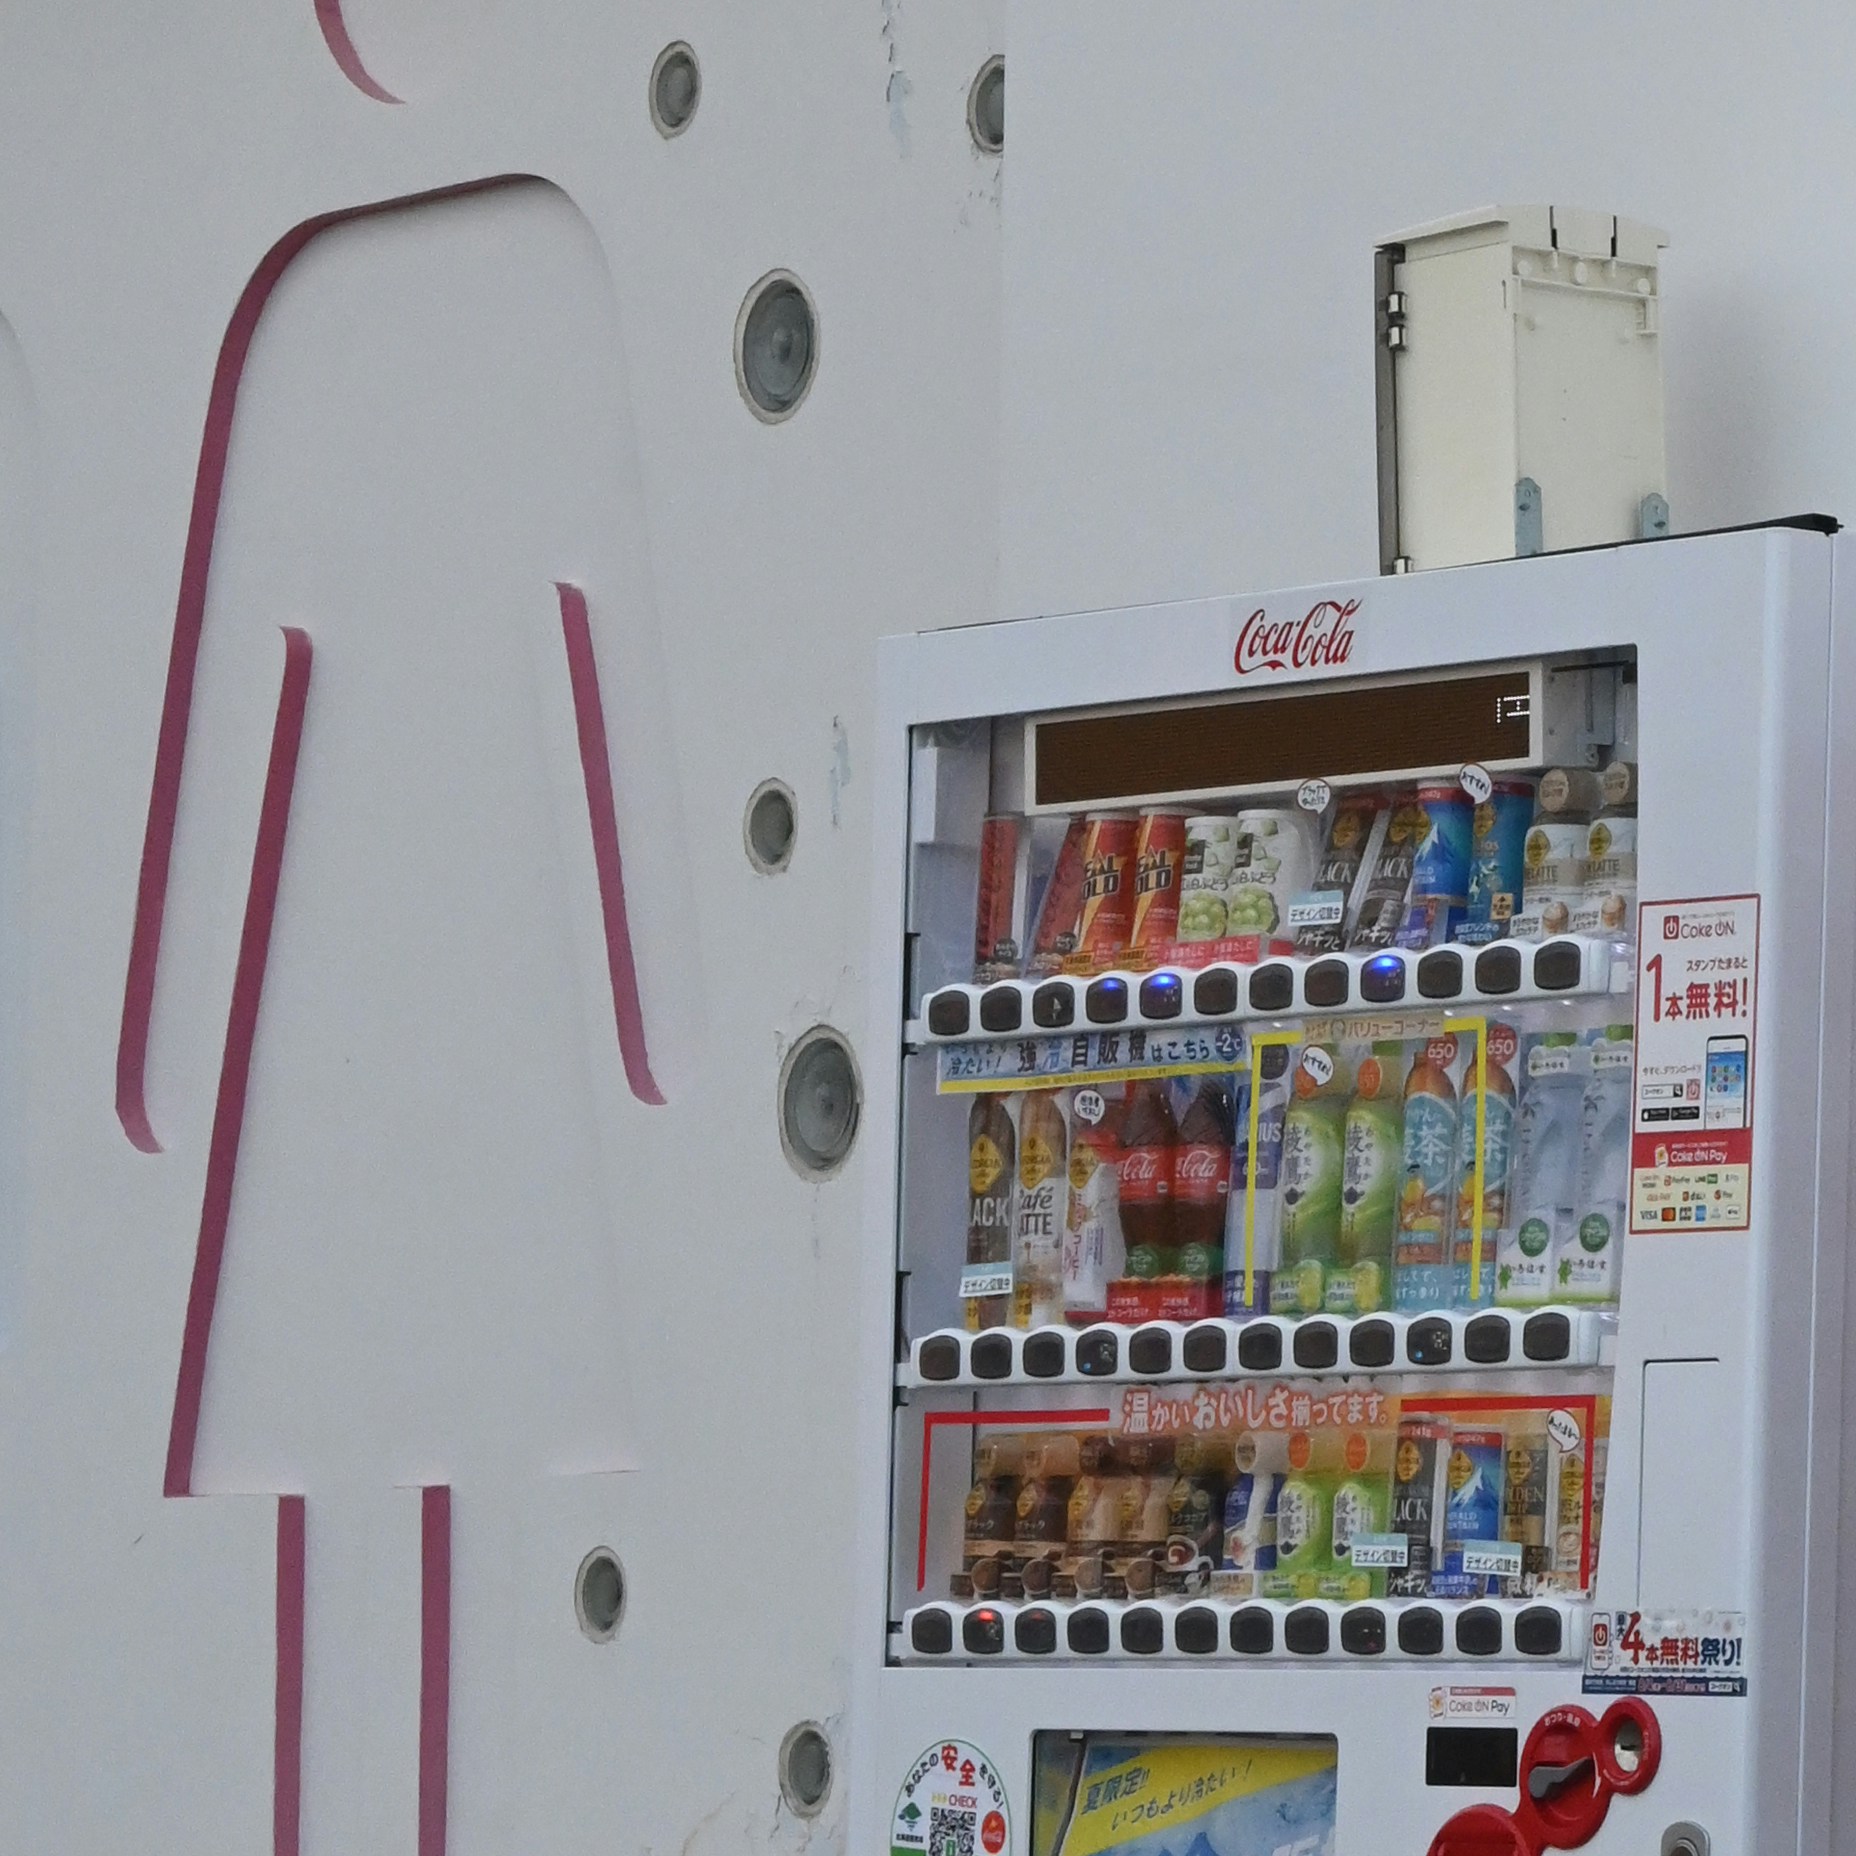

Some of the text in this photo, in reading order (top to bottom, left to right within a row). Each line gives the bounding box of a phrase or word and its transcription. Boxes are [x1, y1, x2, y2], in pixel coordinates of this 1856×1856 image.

[1234, 598, 1364, 675] Coca-Cola
[1681, 922, 1712, 940] Coke
[1646, 953, 1749, 1023] 1本無料!
[1427, 1044, 1455, 1059] 650
[1486, 1039, 1514, 1055] 650
[1620, 1611, 1743, 1666] 4本無料祭り!
[1448, 1699, 1473, 1713] Coke
[1491, 1700, 1510, 1715] Pay
[1111, 1758, 1253, 1831] いつもより冷たい!
